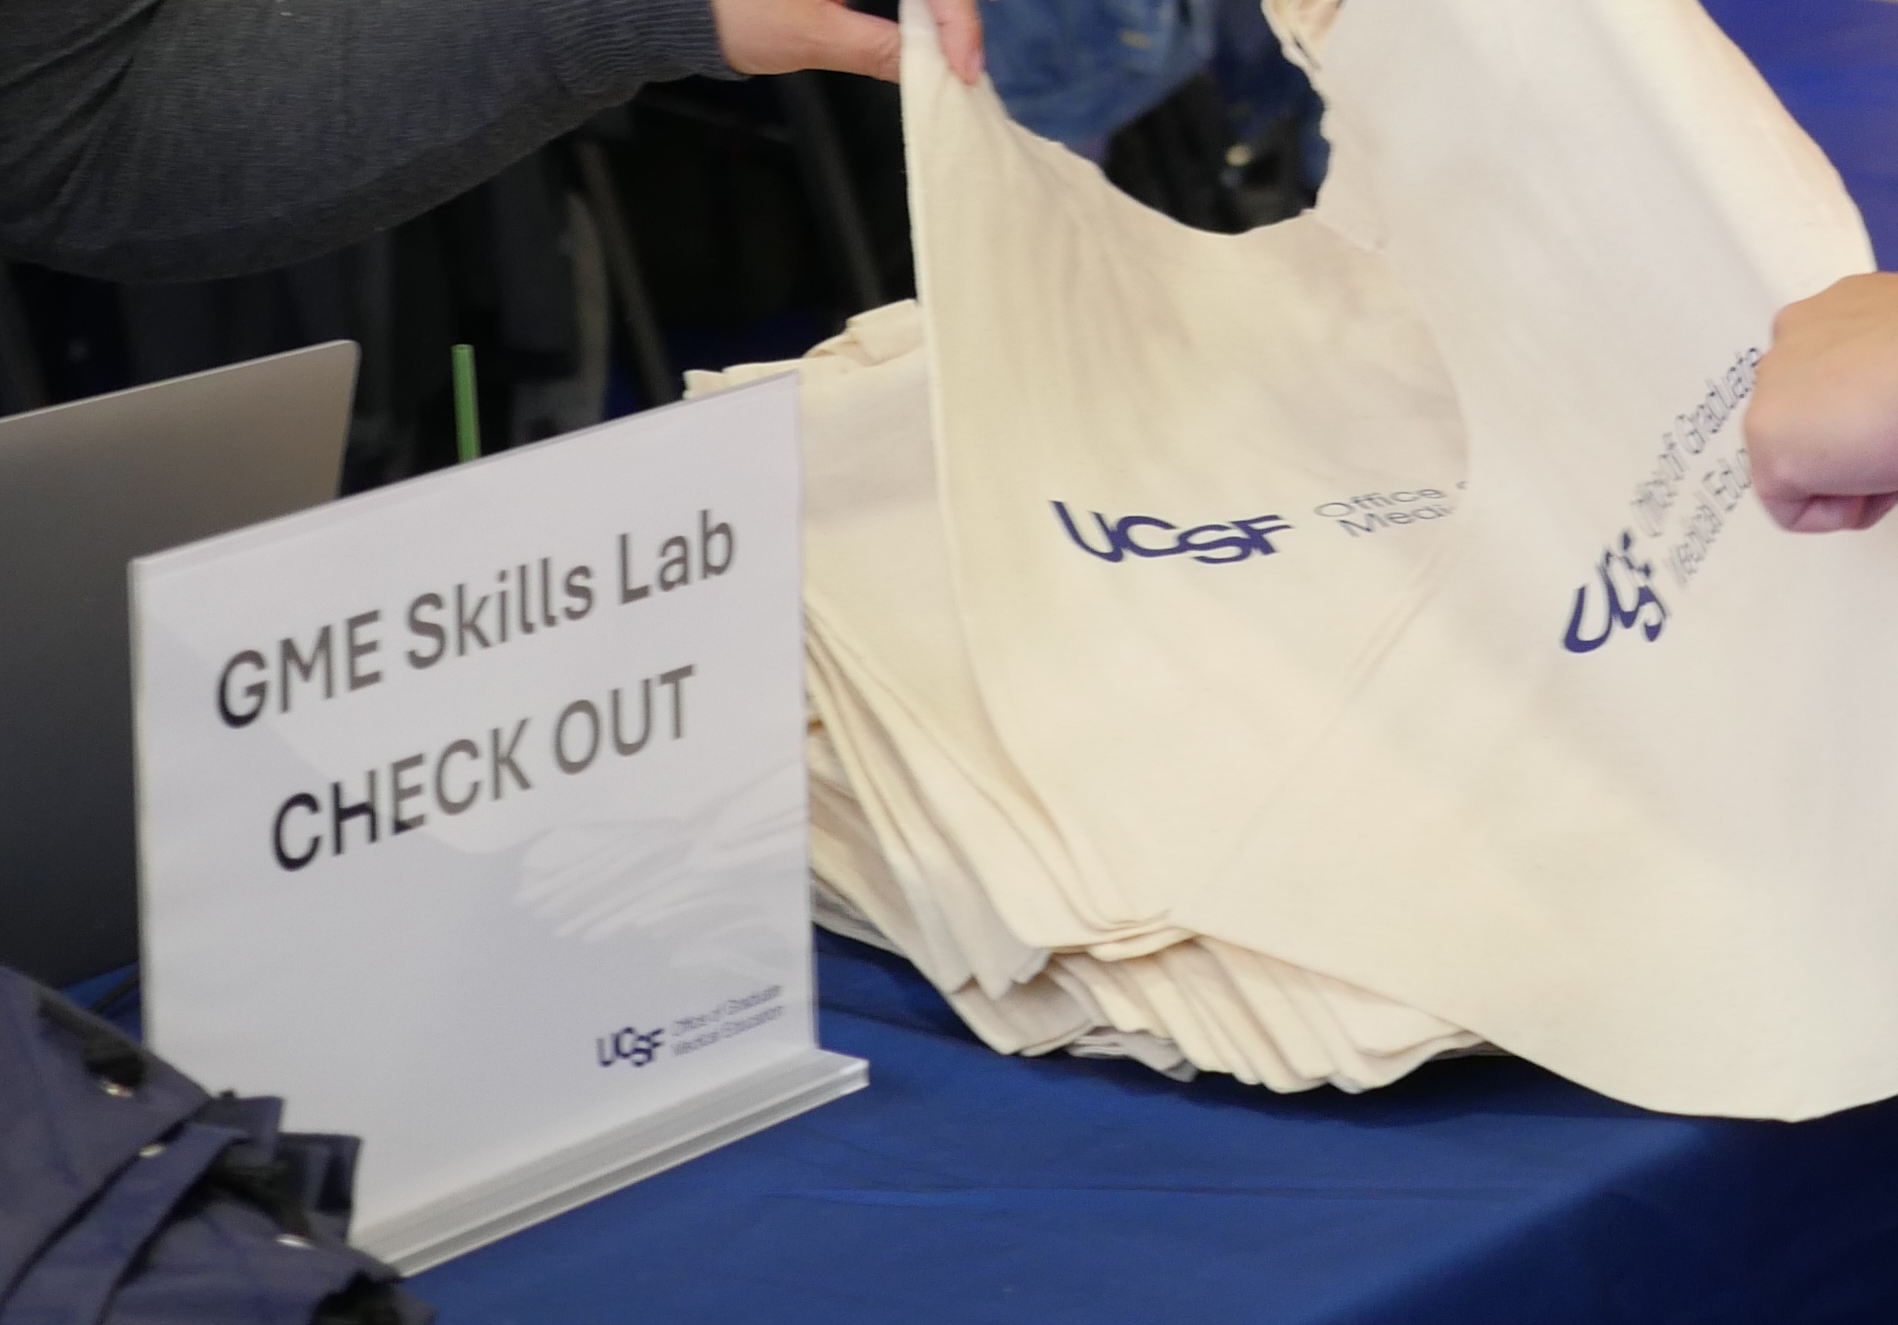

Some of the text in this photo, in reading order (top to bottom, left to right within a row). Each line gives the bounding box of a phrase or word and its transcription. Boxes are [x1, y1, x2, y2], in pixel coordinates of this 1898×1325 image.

[1048, 499, 1294, 565] UCSF
[1313, 488, 1447, 518] Office
[216, 508, 736, 729] GME Skills Lab
[272, 664, 696, 872] CHECK OUT
[597, 1026, 665, 1067] UCSF
